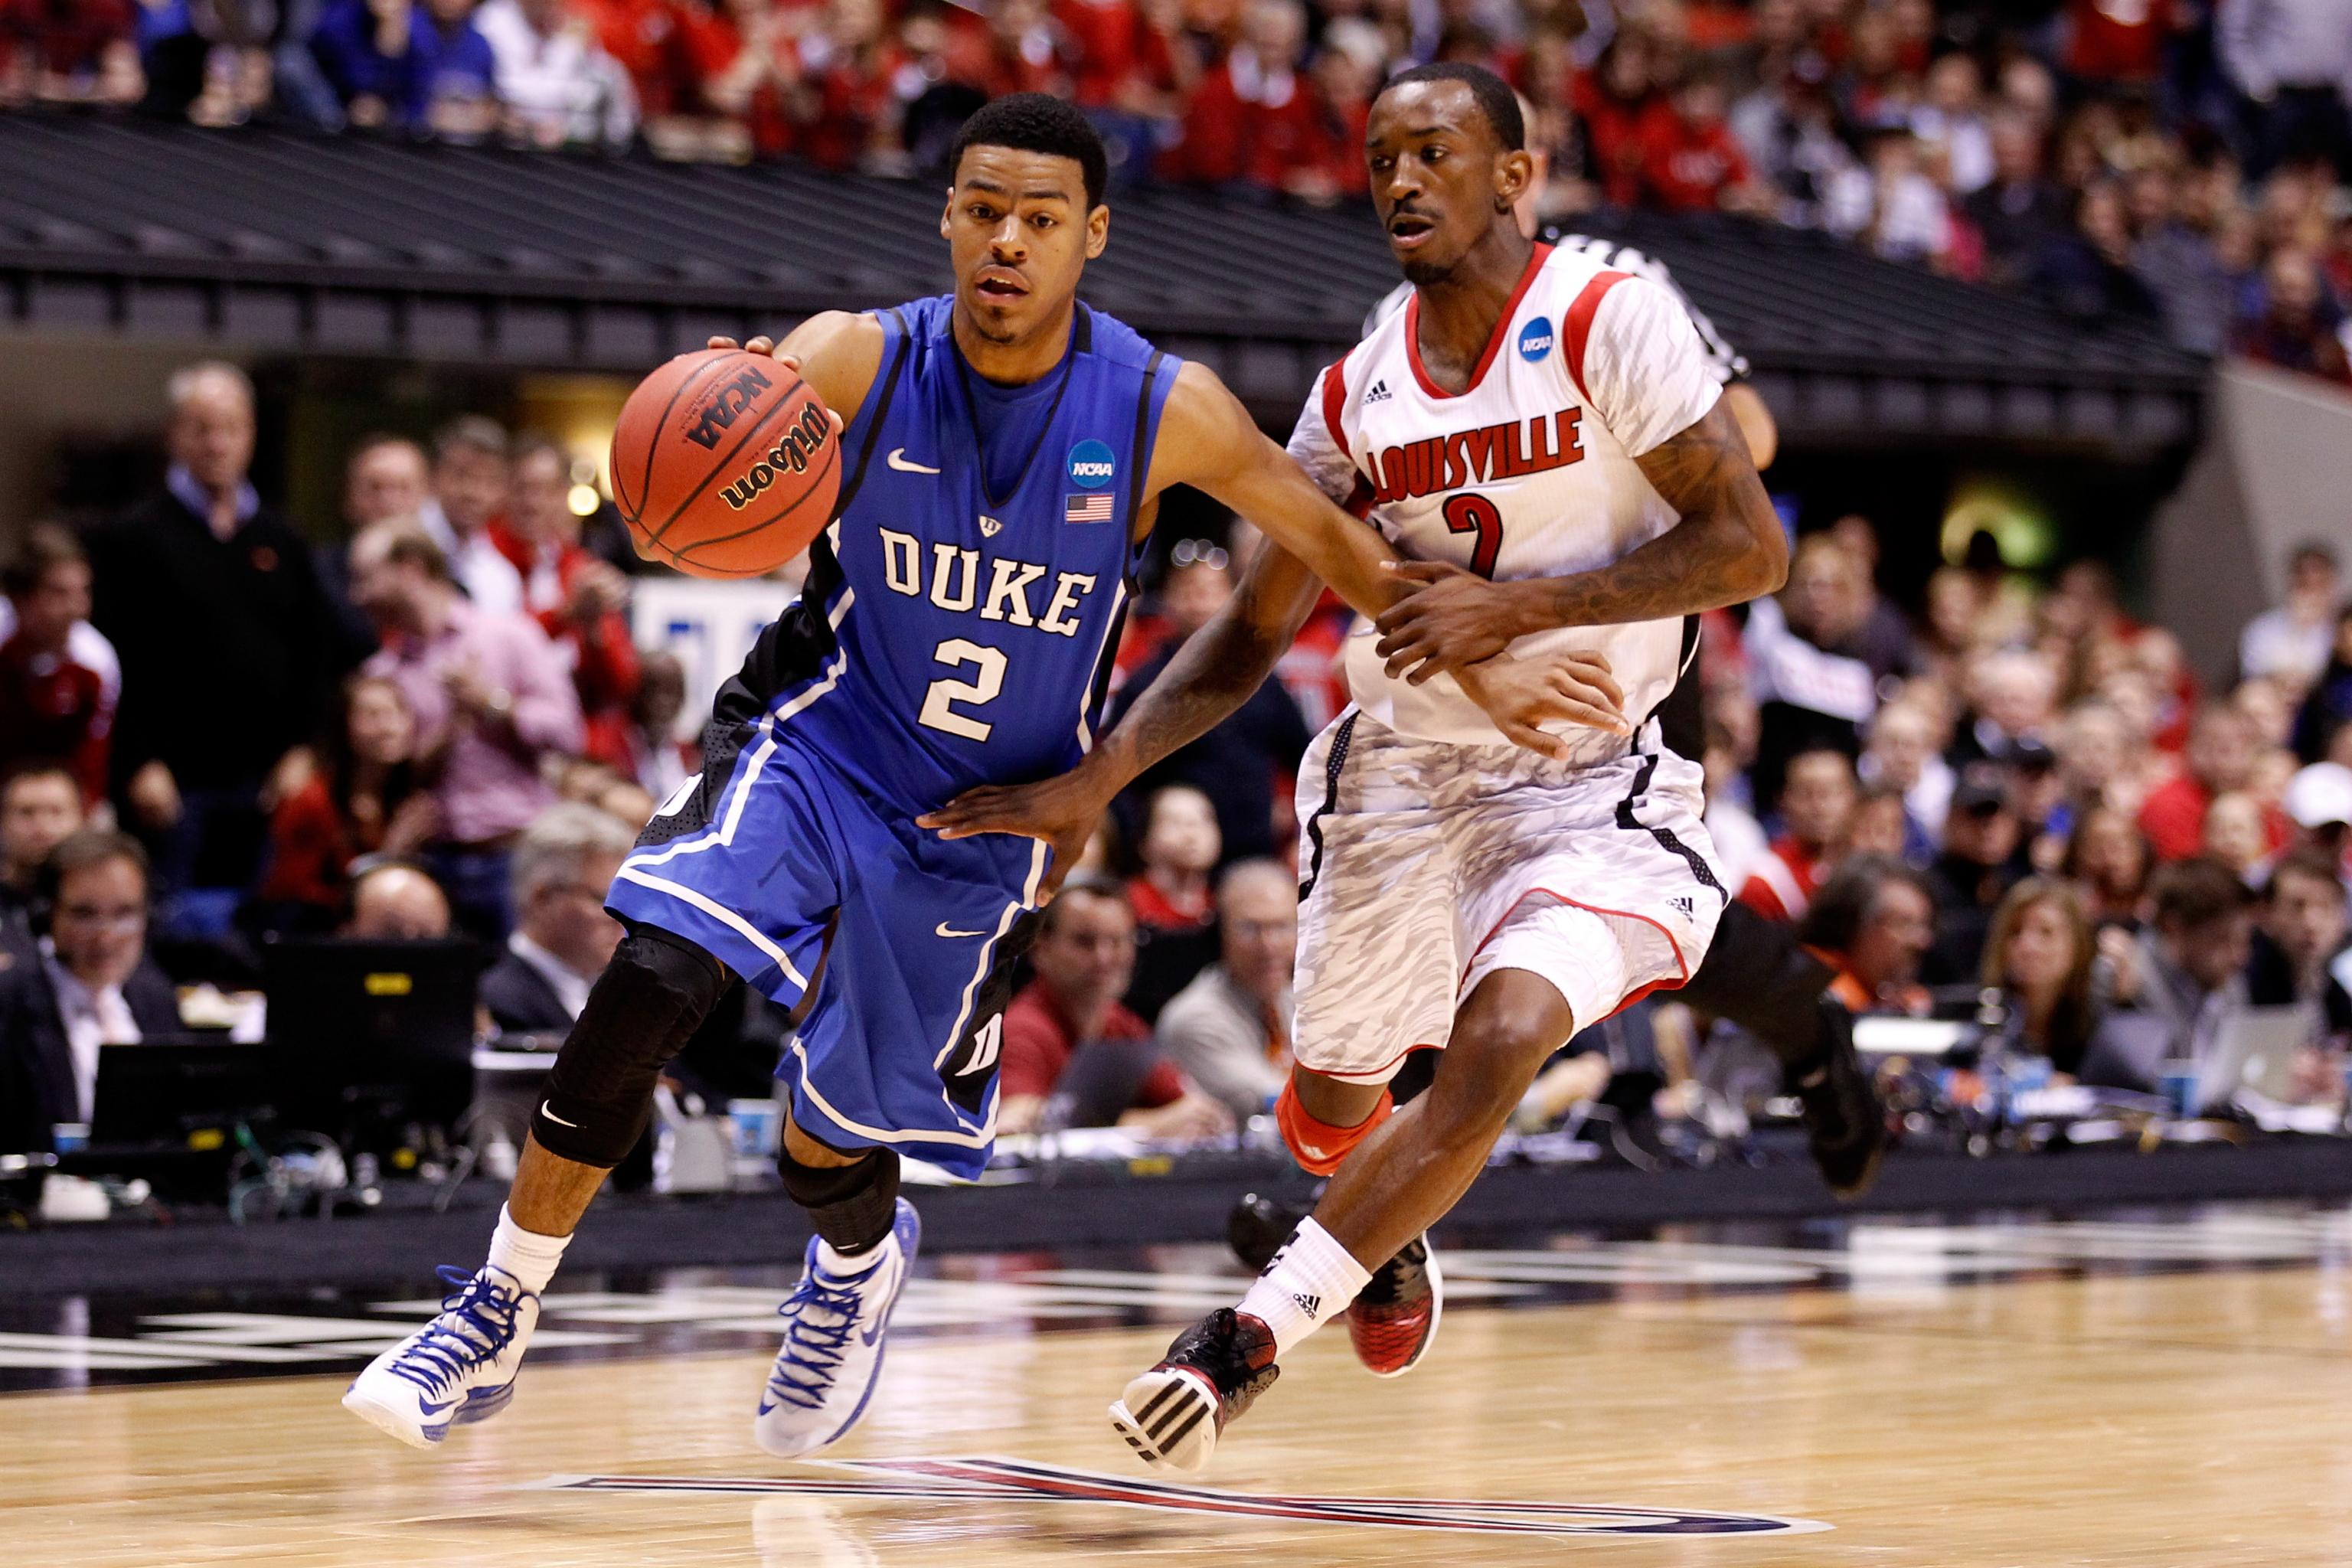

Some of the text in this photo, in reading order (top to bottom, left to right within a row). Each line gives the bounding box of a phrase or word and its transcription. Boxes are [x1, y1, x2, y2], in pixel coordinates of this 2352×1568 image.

[1521, 335, 1552, 352] NCAA
[686, 365, 773, 450] NCAA
[718, 400, 831, 511] Wilson
[1072, 462, 1113, 476] NCAA
[1366, 406, 1585, 505] LOUISVILLE
[878, 524, 1097, 637] DUKE
[1442, 492, 1504, 582] 2
[917, 637, 1009, 743] 2
[953, 1012, 1003, 1077] D
[1292, 1293, 1317, 1320] adidas
